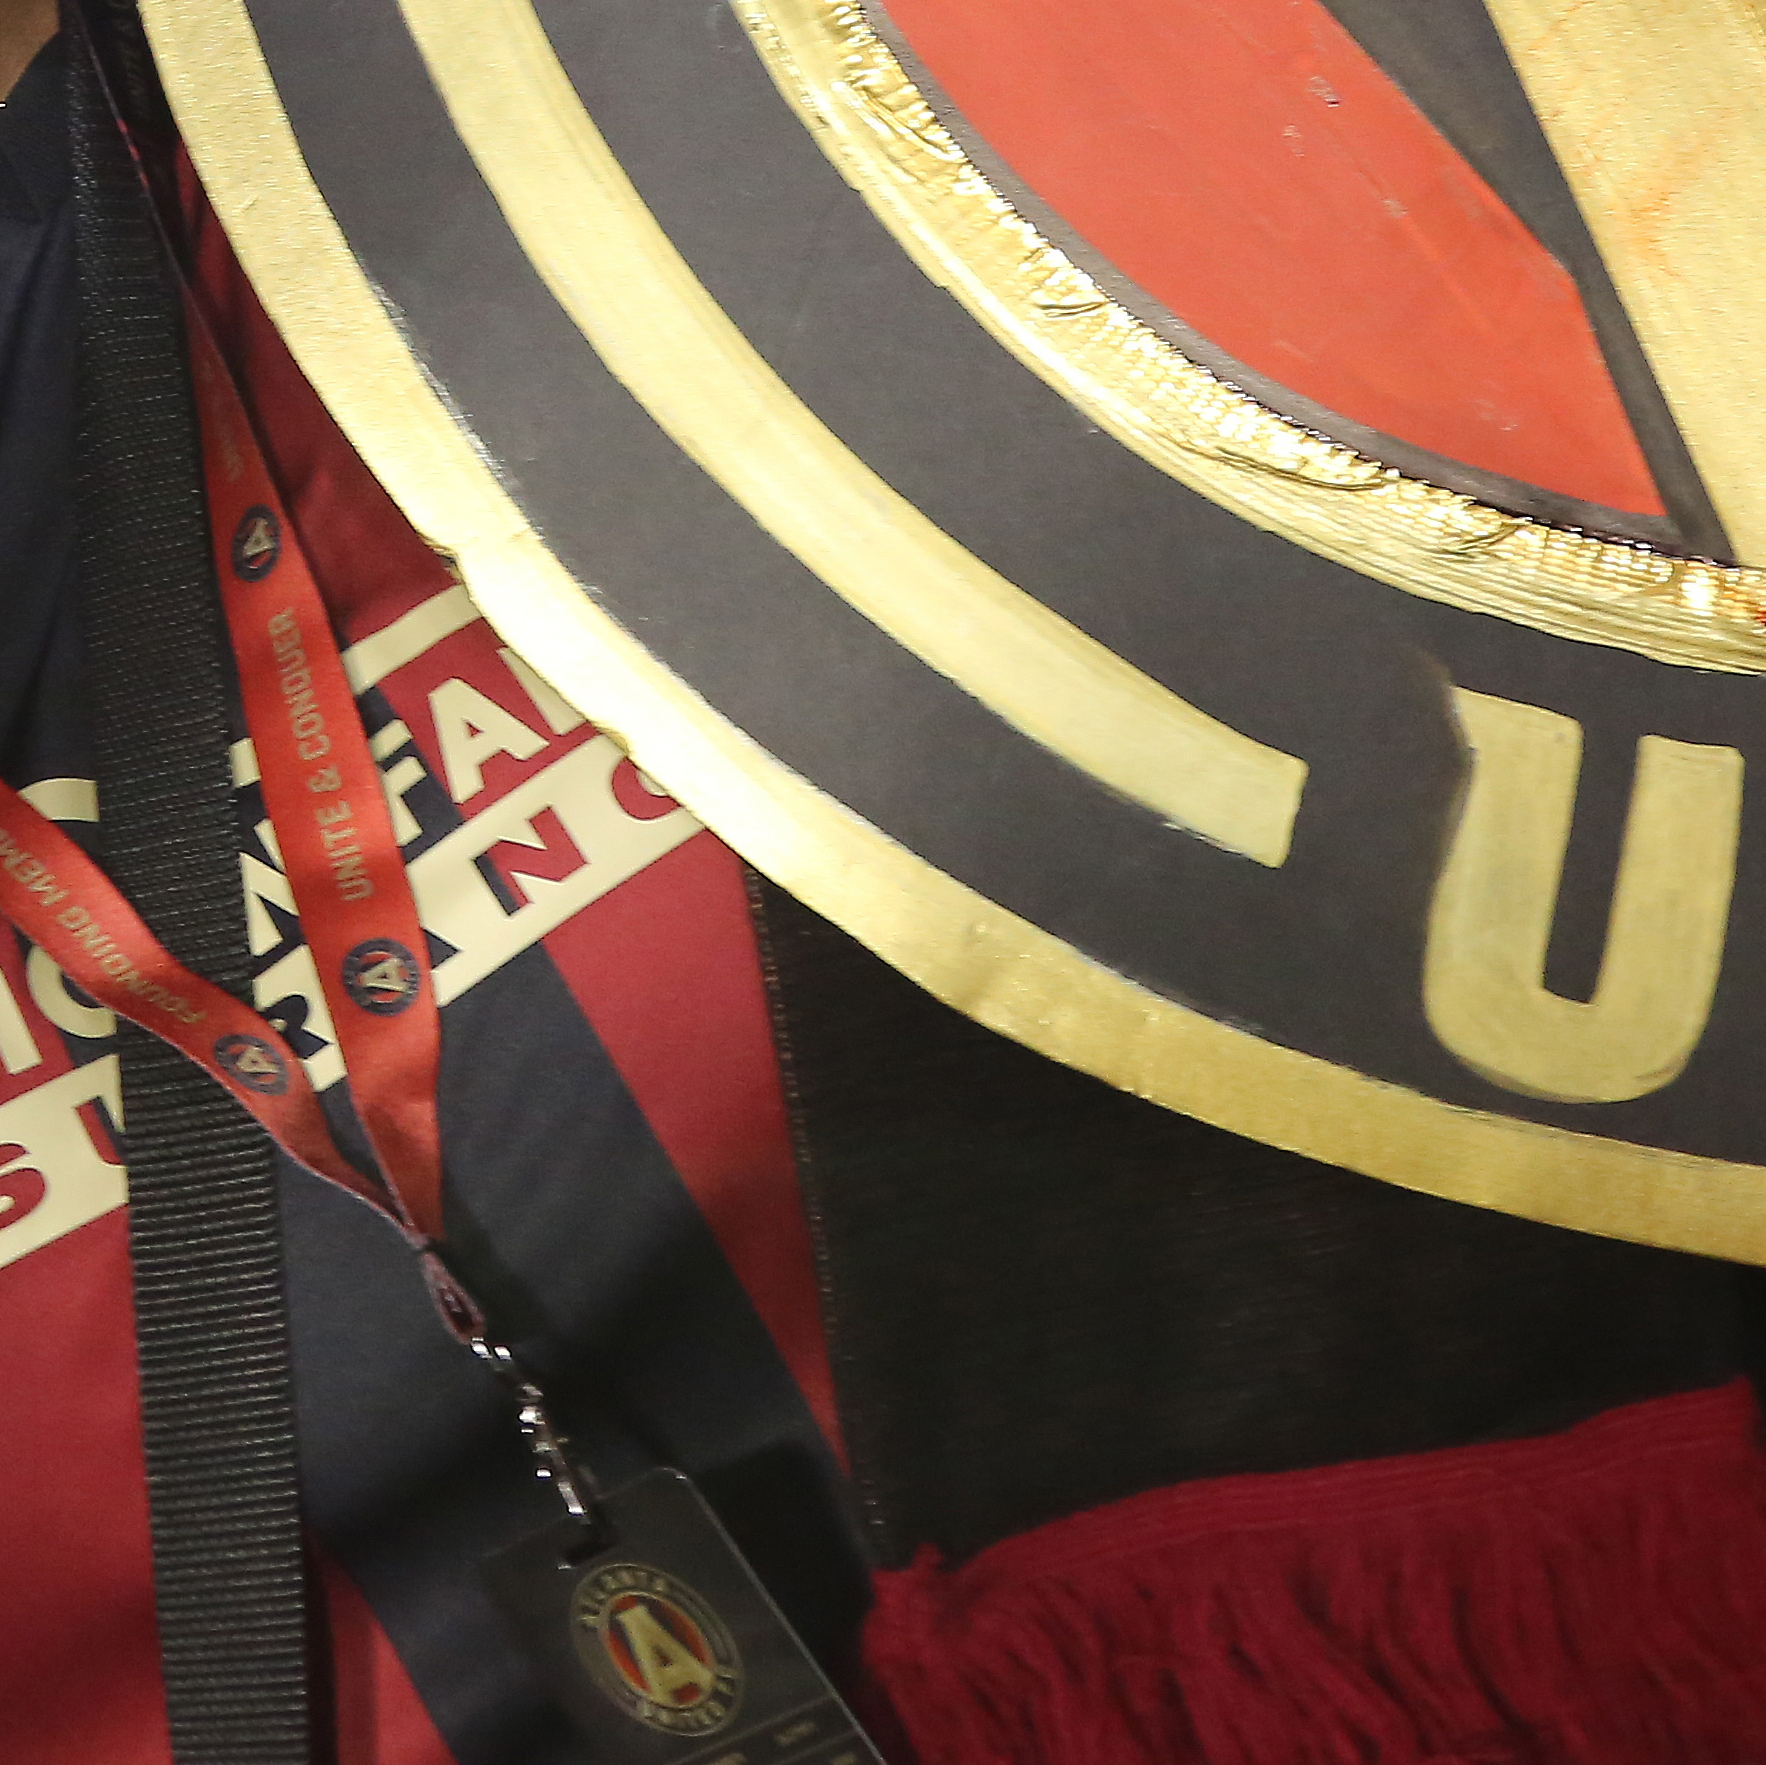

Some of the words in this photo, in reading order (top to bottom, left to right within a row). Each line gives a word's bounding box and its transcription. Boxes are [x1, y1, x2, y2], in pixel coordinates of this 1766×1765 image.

[267, 605, 332, 762] CONQUER
[308, 764, 343, 795] &
[314, 800, 375, 902] UNITE
[55, 905, 207, 1024] FOUNDING
